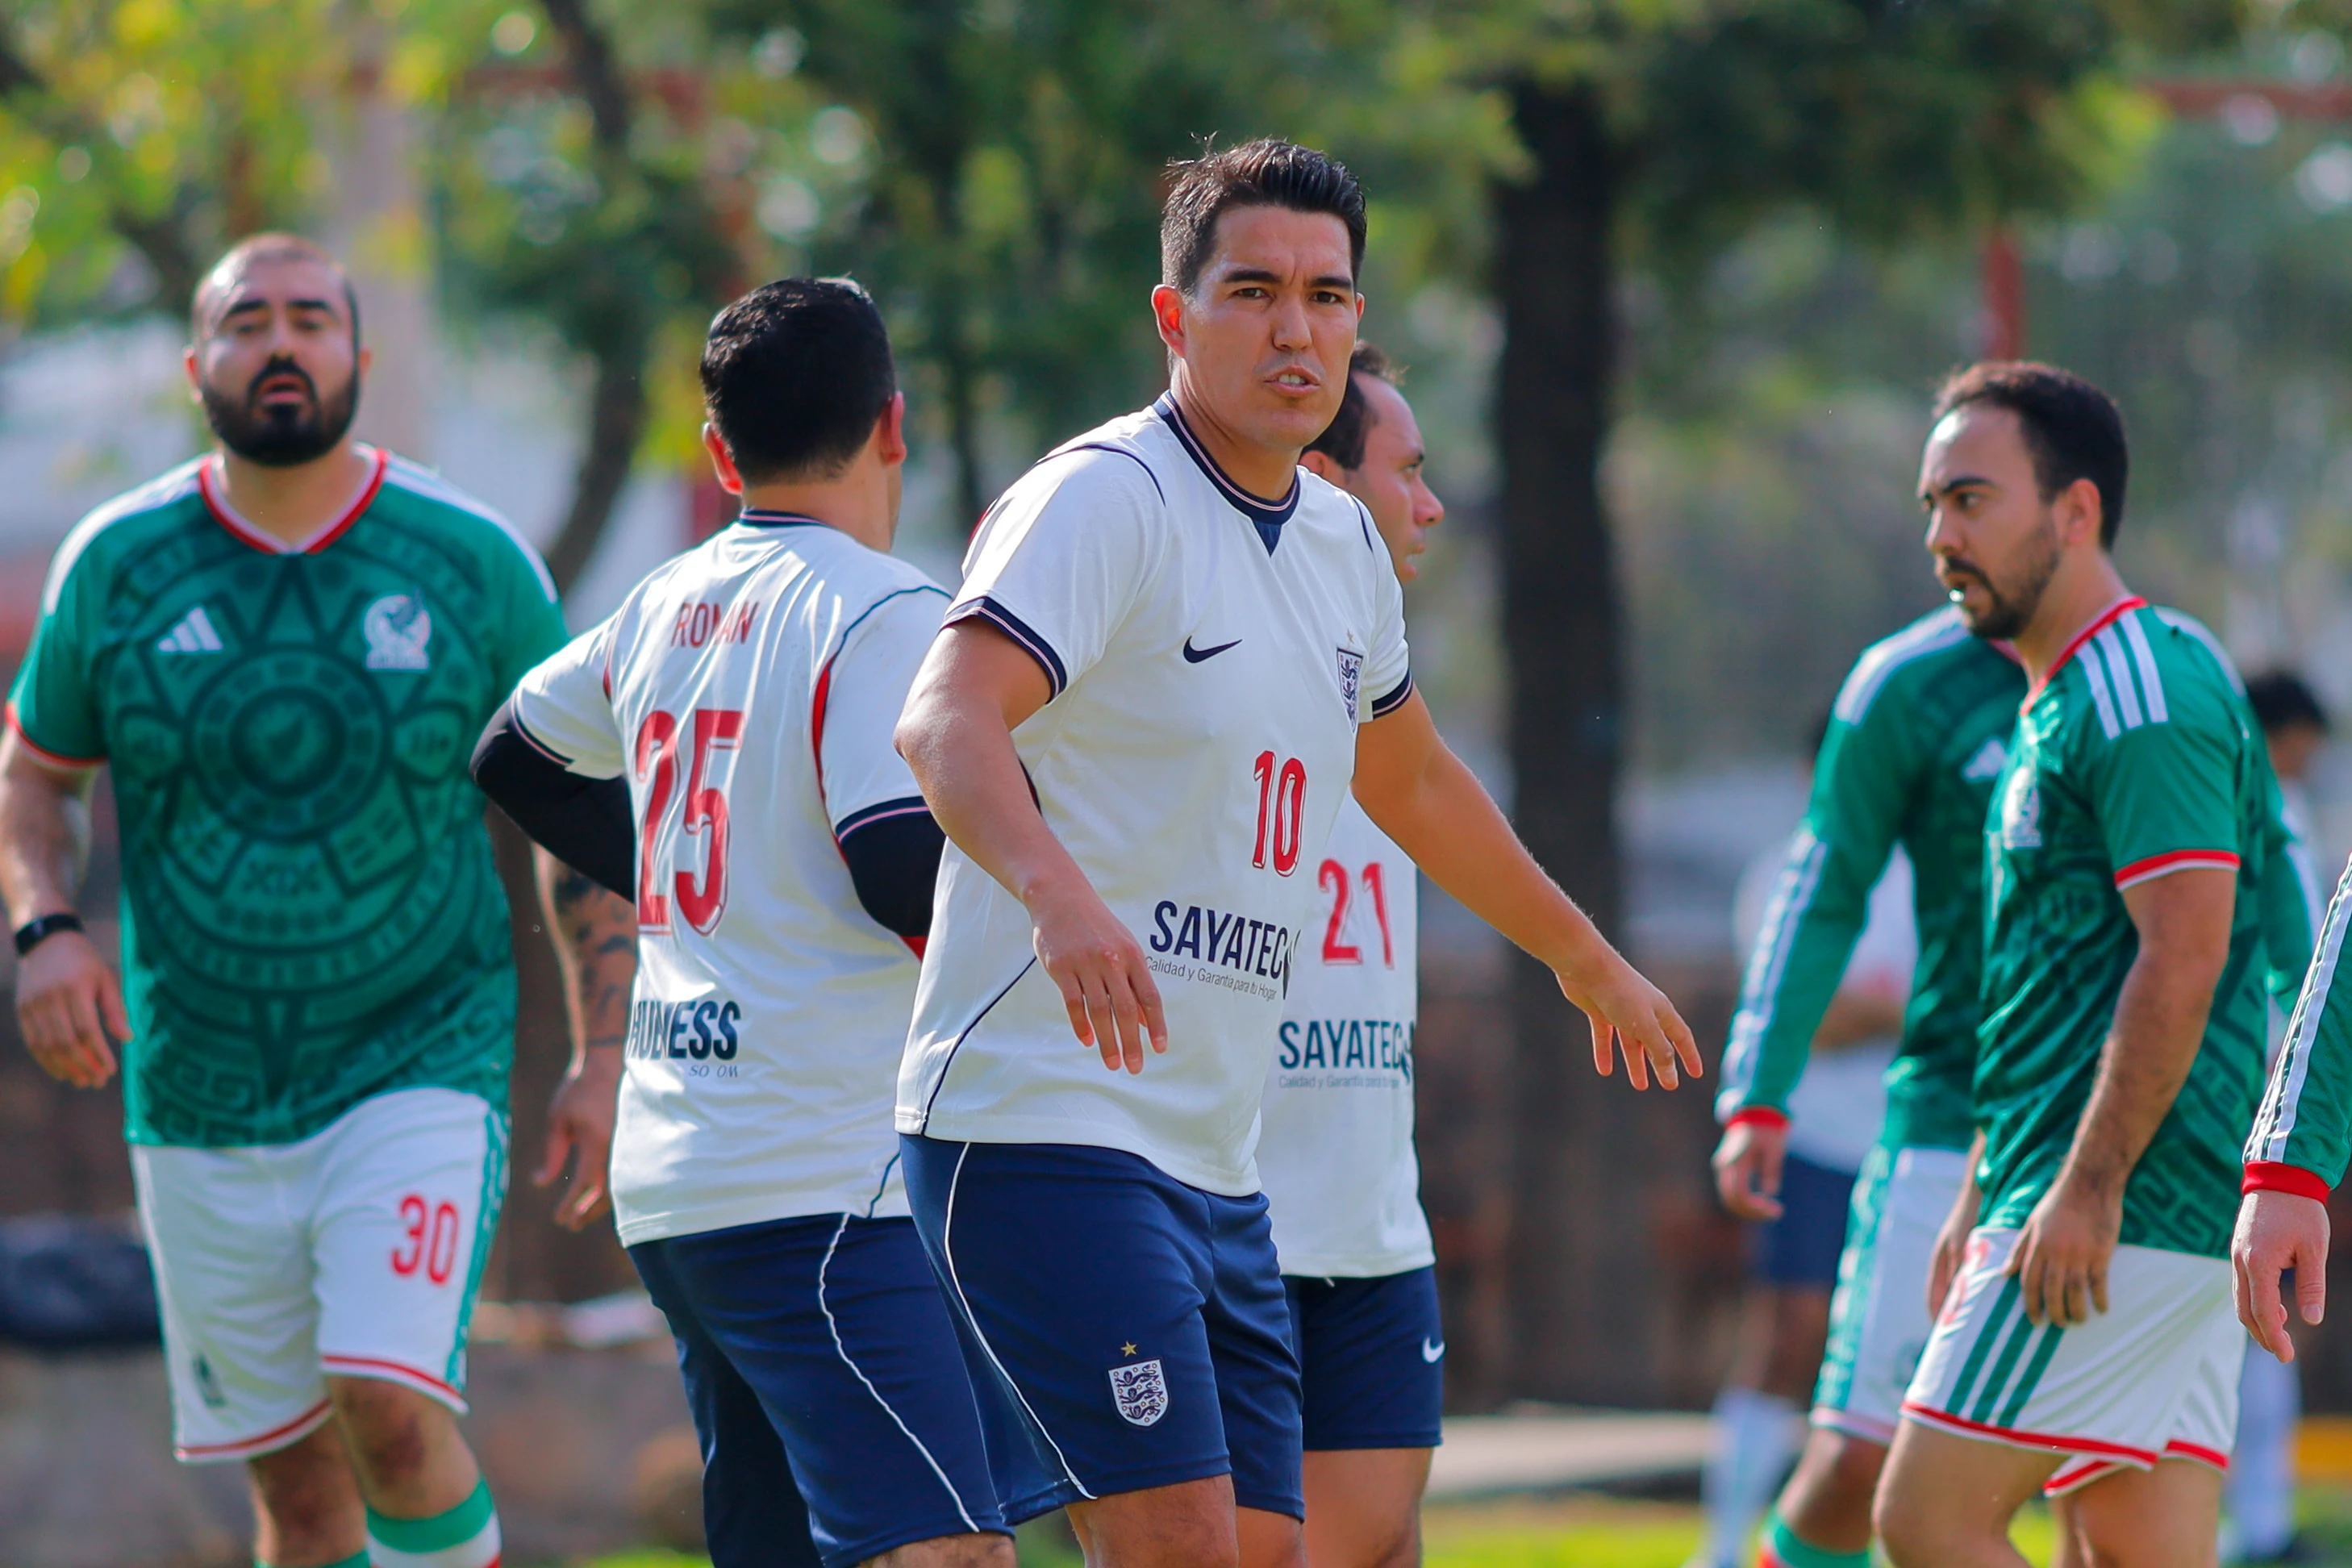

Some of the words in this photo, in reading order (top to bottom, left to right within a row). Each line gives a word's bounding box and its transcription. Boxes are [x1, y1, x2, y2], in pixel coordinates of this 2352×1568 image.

[636, 709, 744, 936] 25
[1252, 750, 1307, 877] 10
[1318, 857, 1395, 970] 21
[1145, 956, 1186, 978] Calidad
[1186, 967, 1195, 982] y
[1232, 979, 1250, 992] para
[1258, 983, 1278, 1002] Hogar
[391, 1194, 459, 1287] 30
